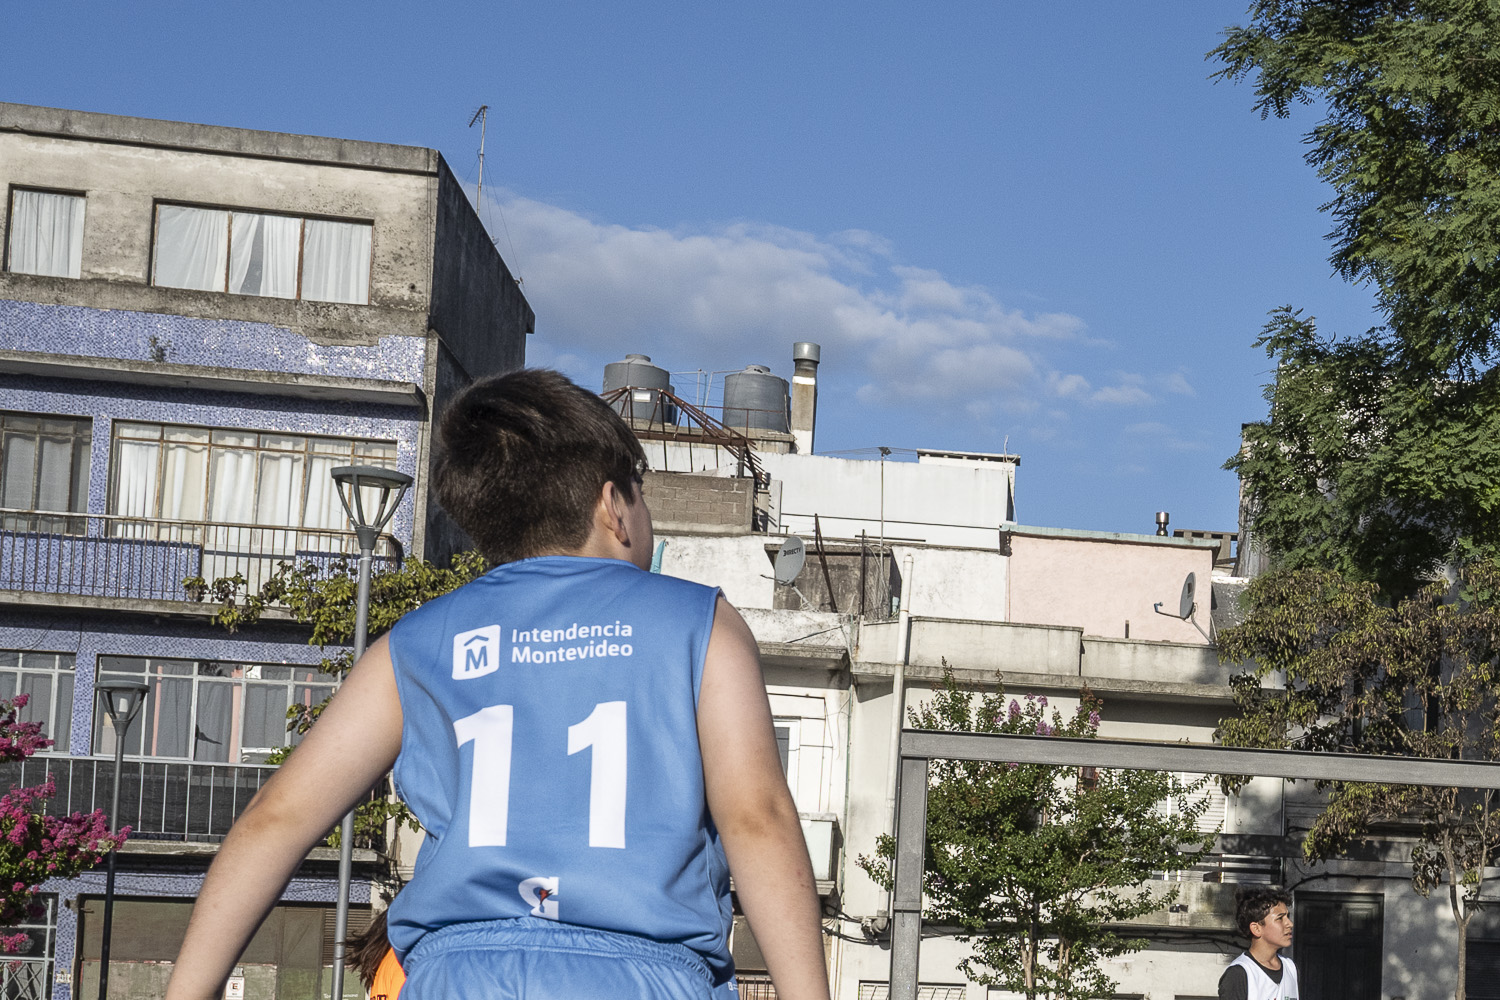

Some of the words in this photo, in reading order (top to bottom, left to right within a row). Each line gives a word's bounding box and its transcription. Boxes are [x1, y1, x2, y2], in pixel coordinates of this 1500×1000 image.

[511, 620, 633, 643] Intendencia
[511, 639, 633, 664] Montevideo
[453, 701, 628, 849] 11
